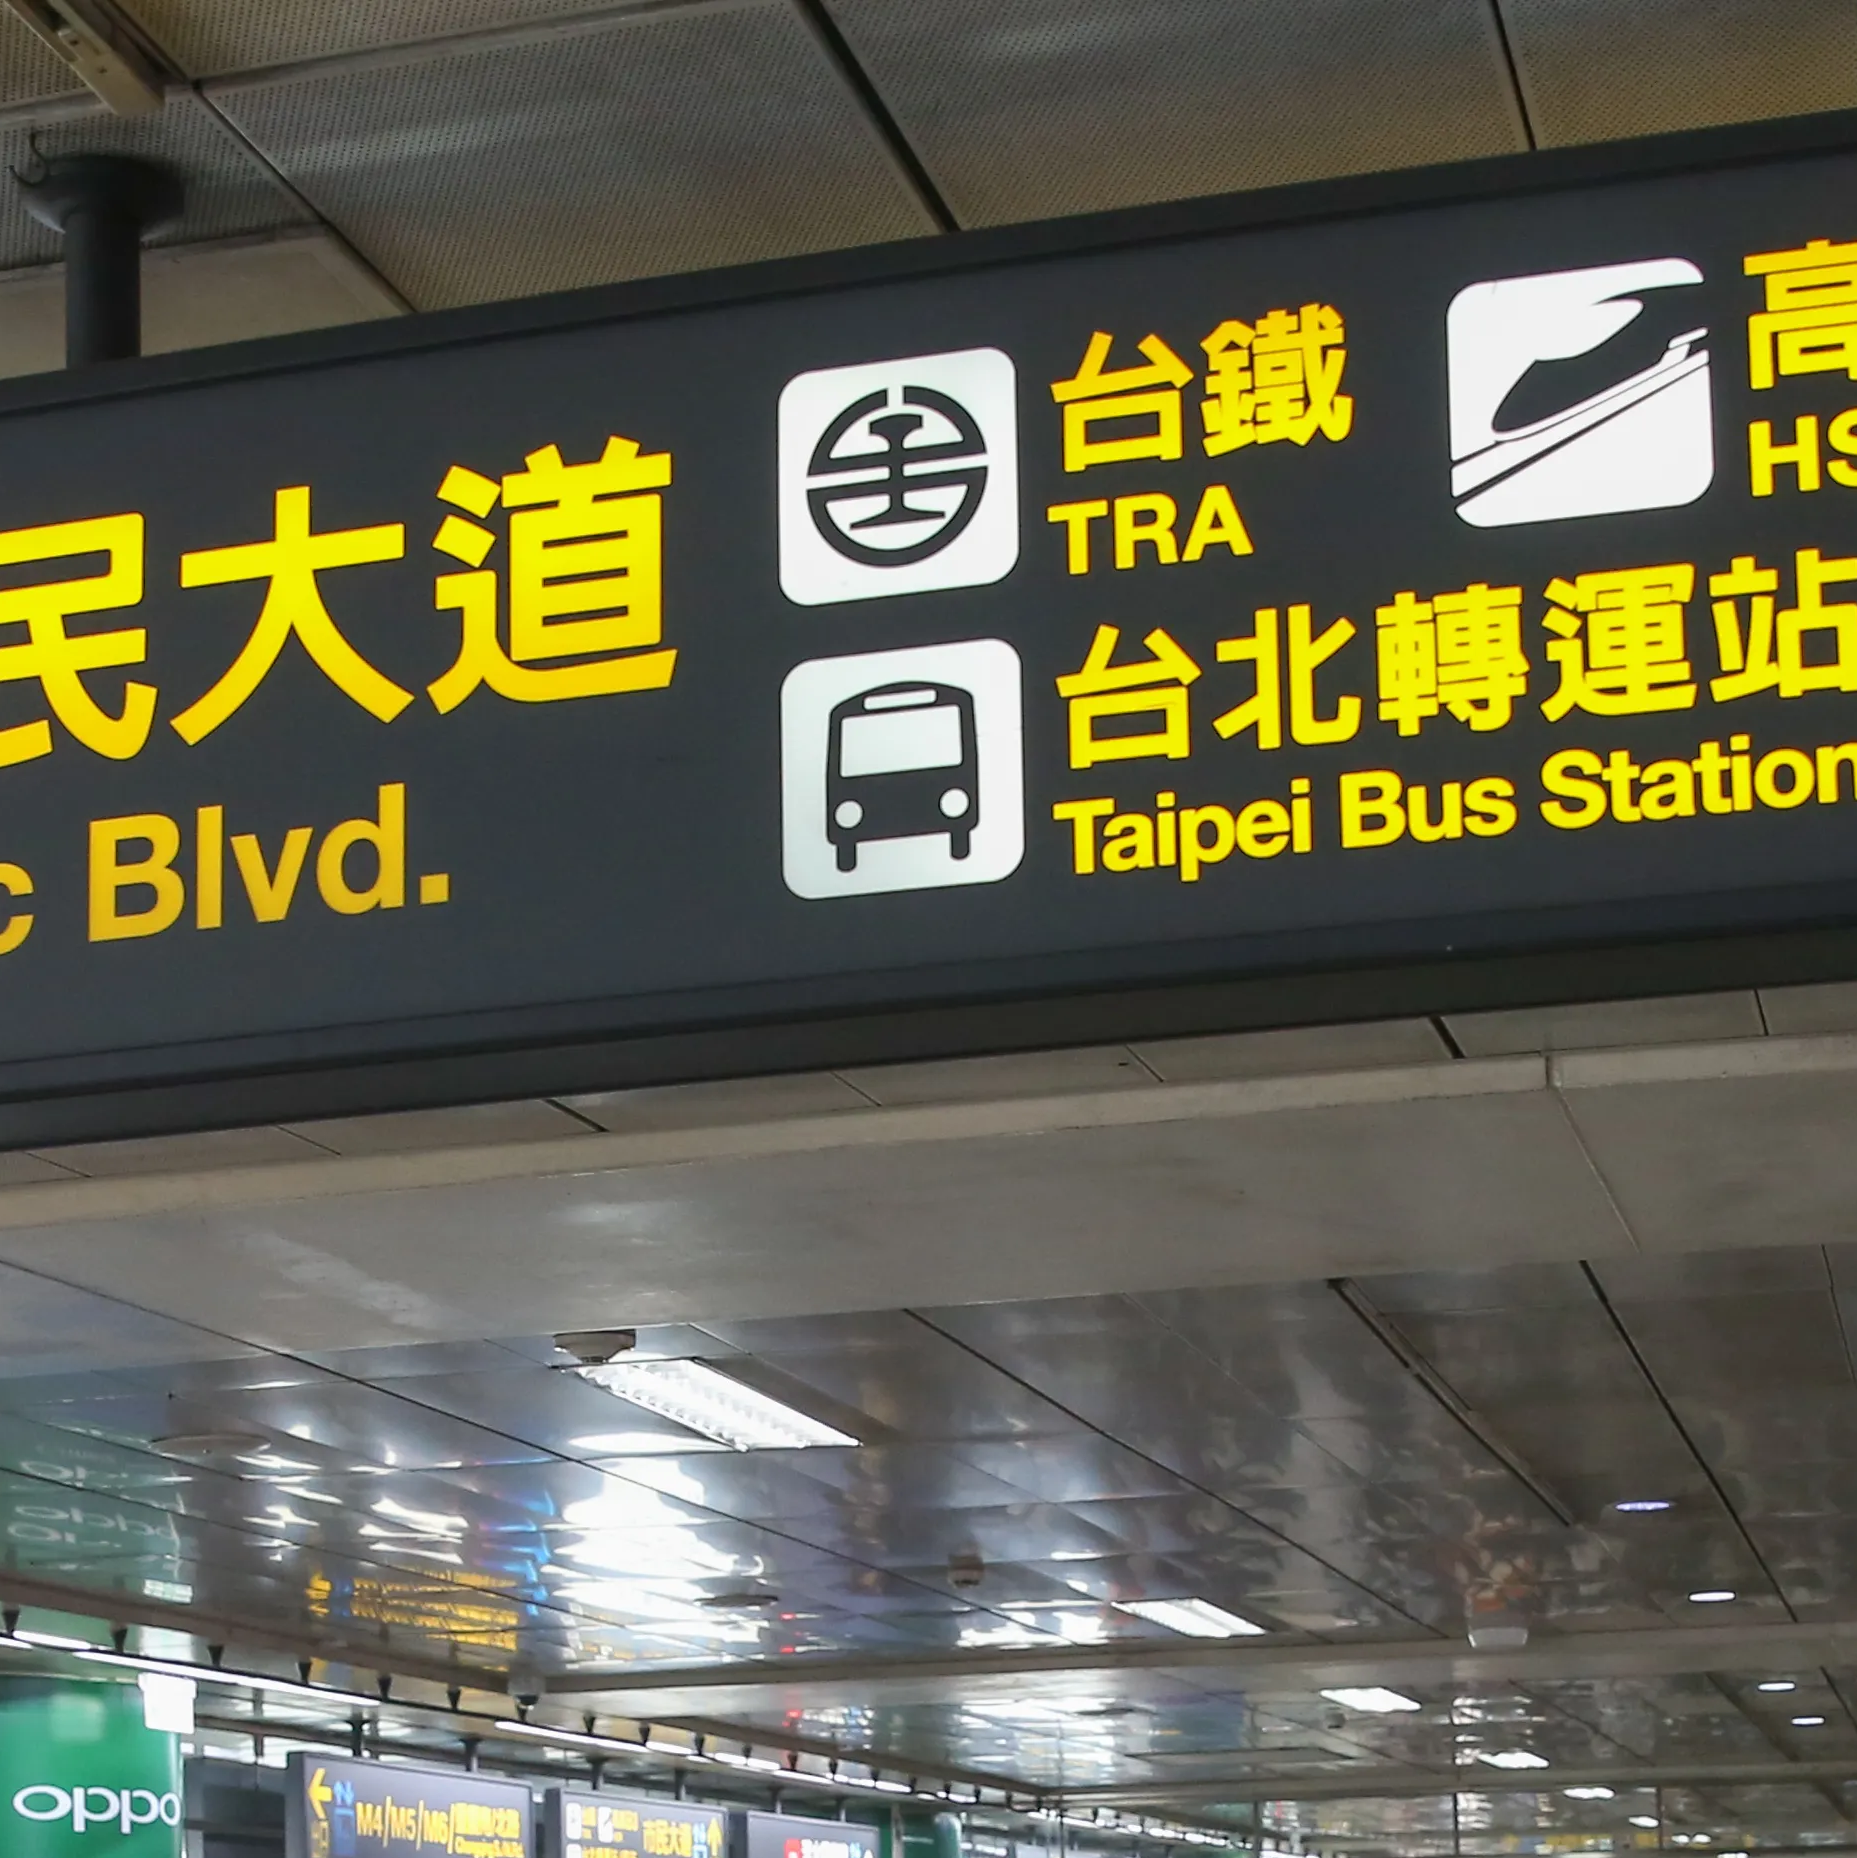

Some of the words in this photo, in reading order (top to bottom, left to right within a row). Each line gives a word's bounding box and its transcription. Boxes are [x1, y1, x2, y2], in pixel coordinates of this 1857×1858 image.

[1051, 303, 1353, 472] 台鐵
[1047, 485, 1253, 574] TRA
[87, 783, 450, 944] Blvd.
[1053, 768, 1314, 884] Taipei
[1338, 762, 1518, 852] Bus
[12, 1784, 181, 1835] oppo
